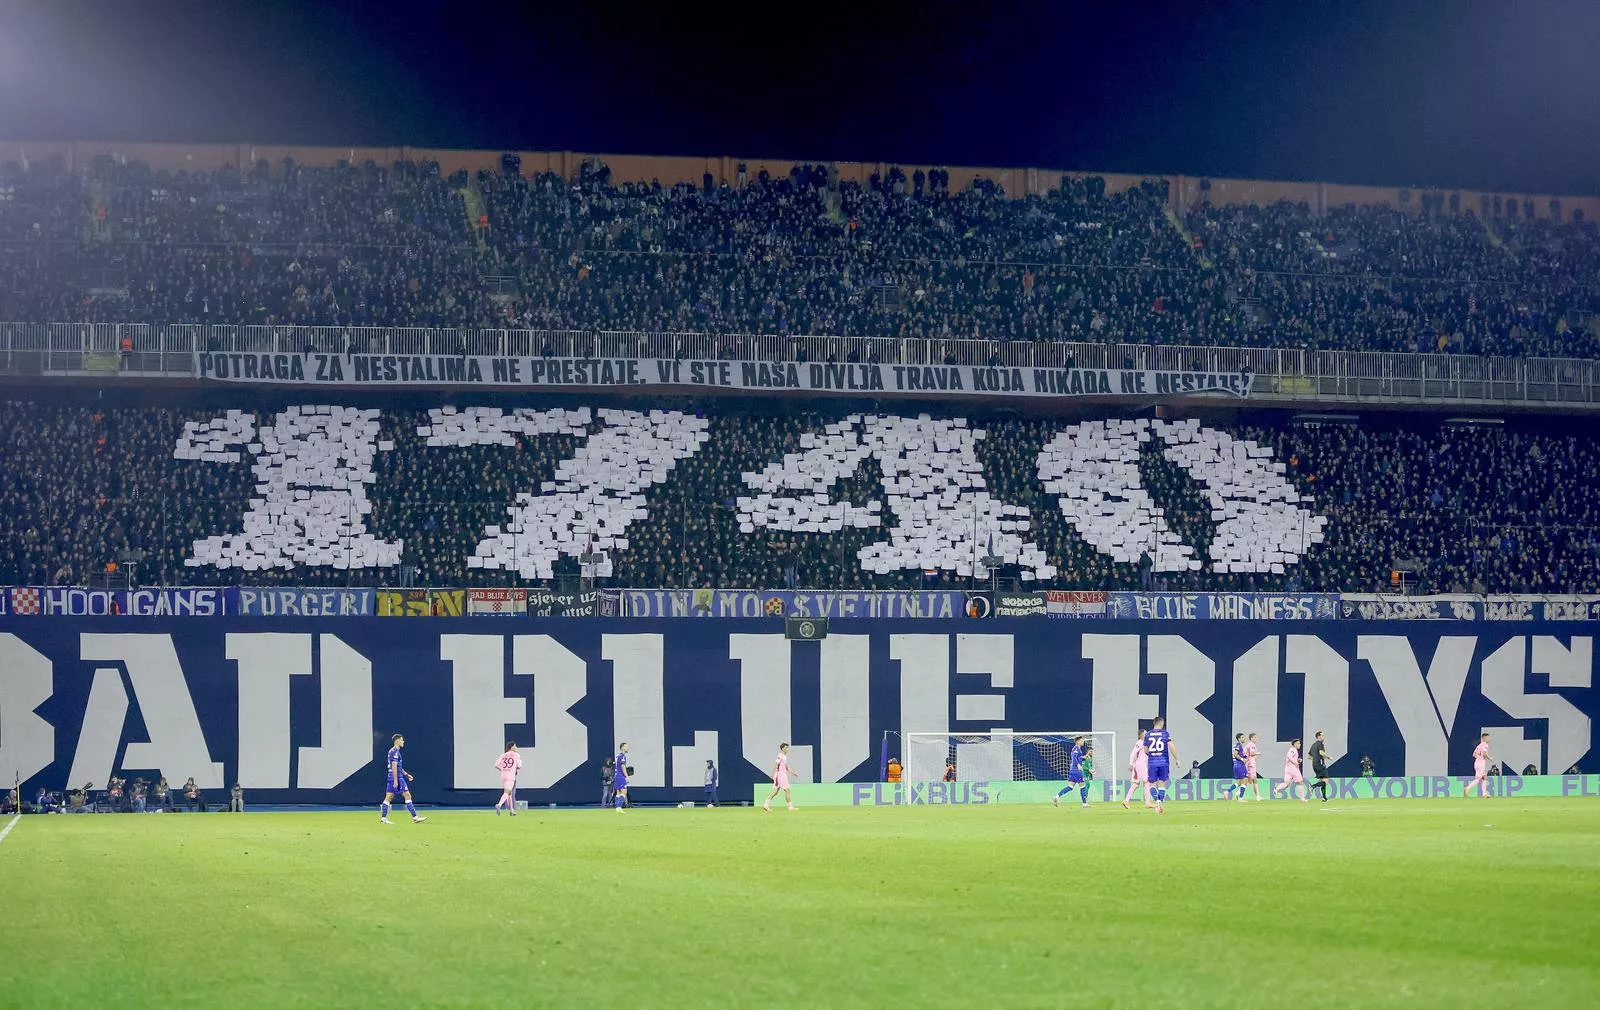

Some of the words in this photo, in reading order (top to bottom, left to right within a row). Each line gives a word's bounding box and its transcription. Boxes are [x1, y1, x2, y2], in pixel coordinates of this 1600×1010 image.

[199, 353, 304, 380] POTRAGA
[315, 354, 344, 381] ZA
[353, 355, 483, 383] NESTALIMA
[492, 358, 521, 383] NE
[531, 358, 646, 385] PRESTAJE.
[657, 360, 682, 384] VI
[691, 361, 732, 386] STE
[742, 360, 800, 388] NAŠA
[809, 363, 884, 390] DIVLJA
[893, 366, 964, 391] TRAVA
[971, 367, 1025, 392] KOJA
[1033, 368, 1113, 394] NIKADA
[1120, 371, 1147, 394] NE
[47, 589, 217, 616] HOOLIGANS
[240, 590, 370, 617] PURGERI
[470, 591, 485, 600] BAD
[487, 592, 505, 600] BLUE
[579, 591, 597, 603] uz
[790, 592, 953, 618] SVETINJA
[1133, 595, 1199, 620] BLUE
[1208, 595, 1314, 620] MADNESS
[440, 633, 1014, 790] BLUE
[1082, 633, 1593, 780] BOYS
[1148, 737, 1165, 752] 26
[502, 757, 515, 769] 39
[1103, 779, 1234, 802] FLBUS
[1270, 777, 1359, 800] BOOK
[1366, 776, 1450, 799] YOUR
[1456, 775, 1524, 797] TRIP
